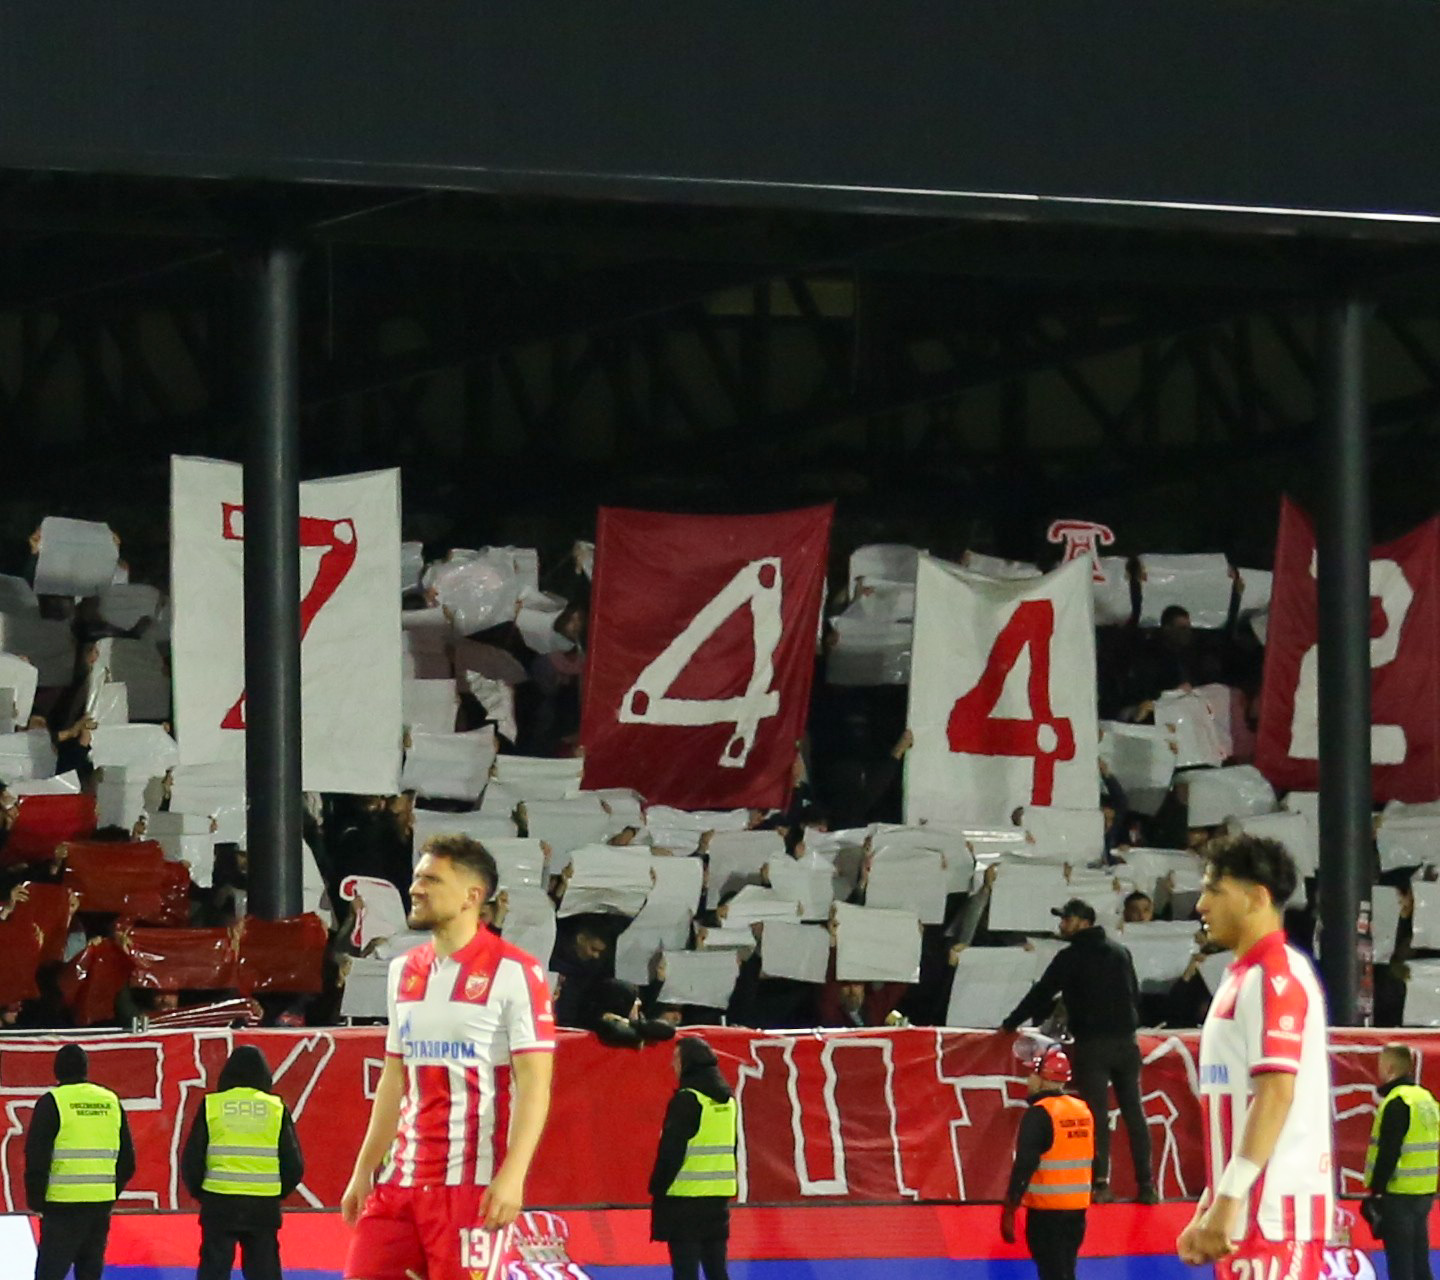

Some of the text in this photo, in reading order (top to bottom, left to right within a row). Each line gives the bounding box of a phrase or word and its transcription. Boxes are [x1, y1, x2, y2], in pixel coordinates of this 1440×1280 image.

[221, 502, 358, 730] 7
[619, 556, 782, 768] 4
[947, 598, 1076, 807] 4
[1287, 549, 1414, 766] 2
[458, 1227, 491, 1269] 13
